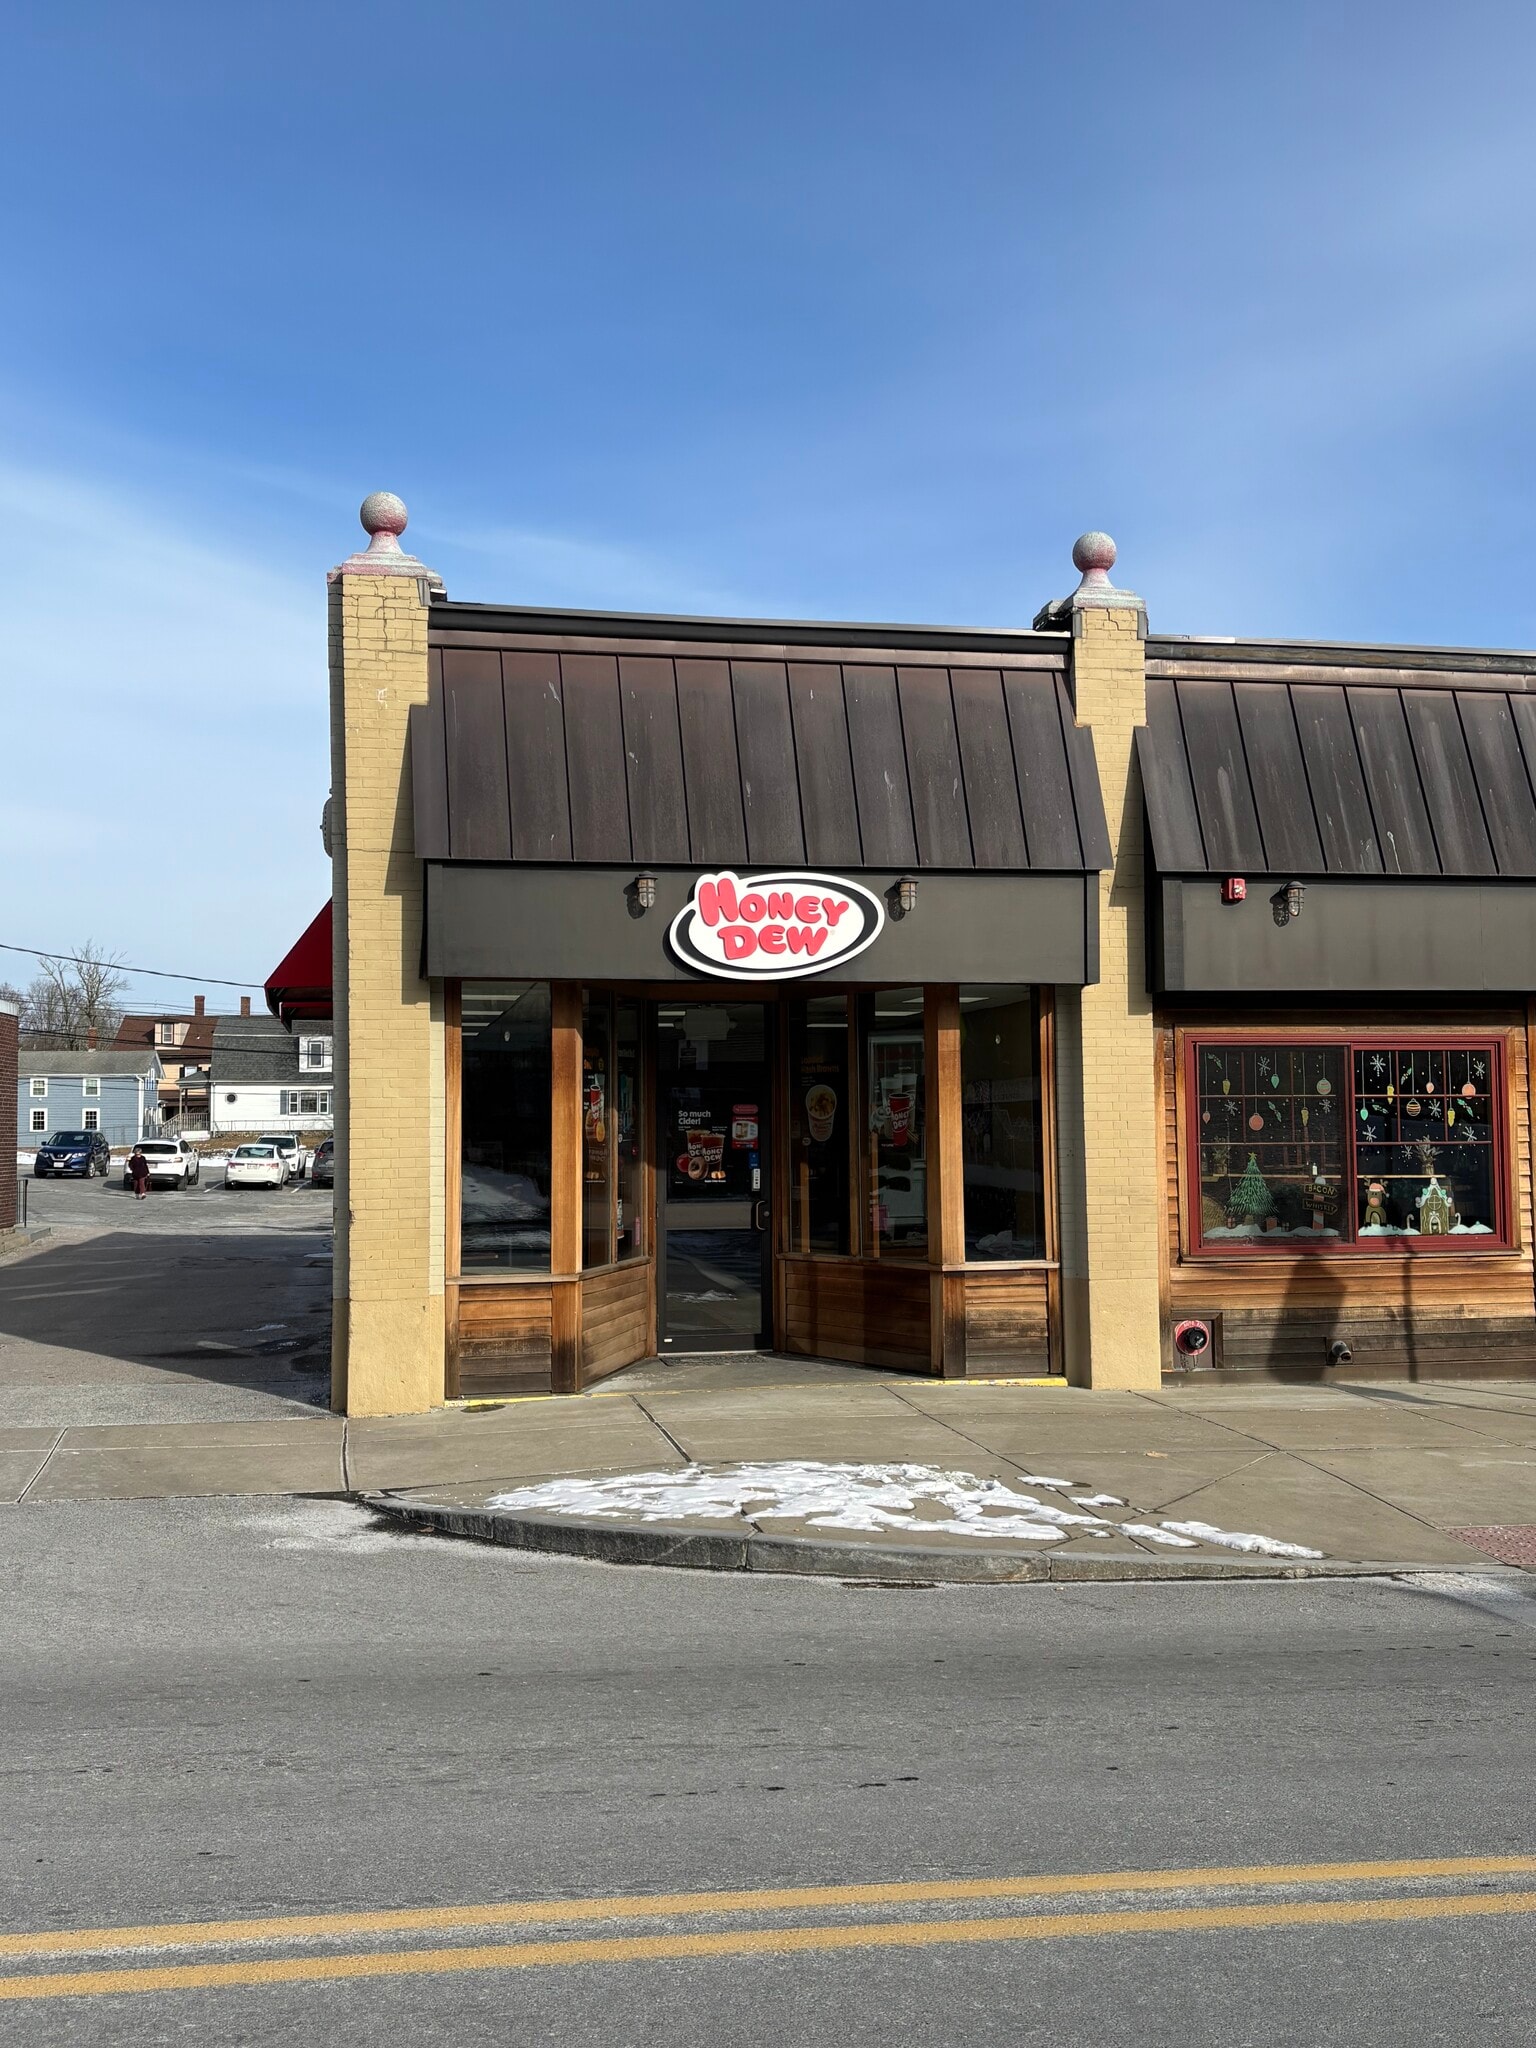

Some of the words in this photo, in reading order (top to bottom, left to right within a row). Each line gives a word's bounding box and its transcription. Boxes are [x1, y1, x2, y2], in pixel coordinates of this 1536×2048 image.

[698, 877, 849, 926] HONEY
[717, 924, 828, 960] DEW
[678, 1110, 688, 1118] So
[689, 1110, 711, 1118] much
[1308, 1185, 1334, 1195] BACON
